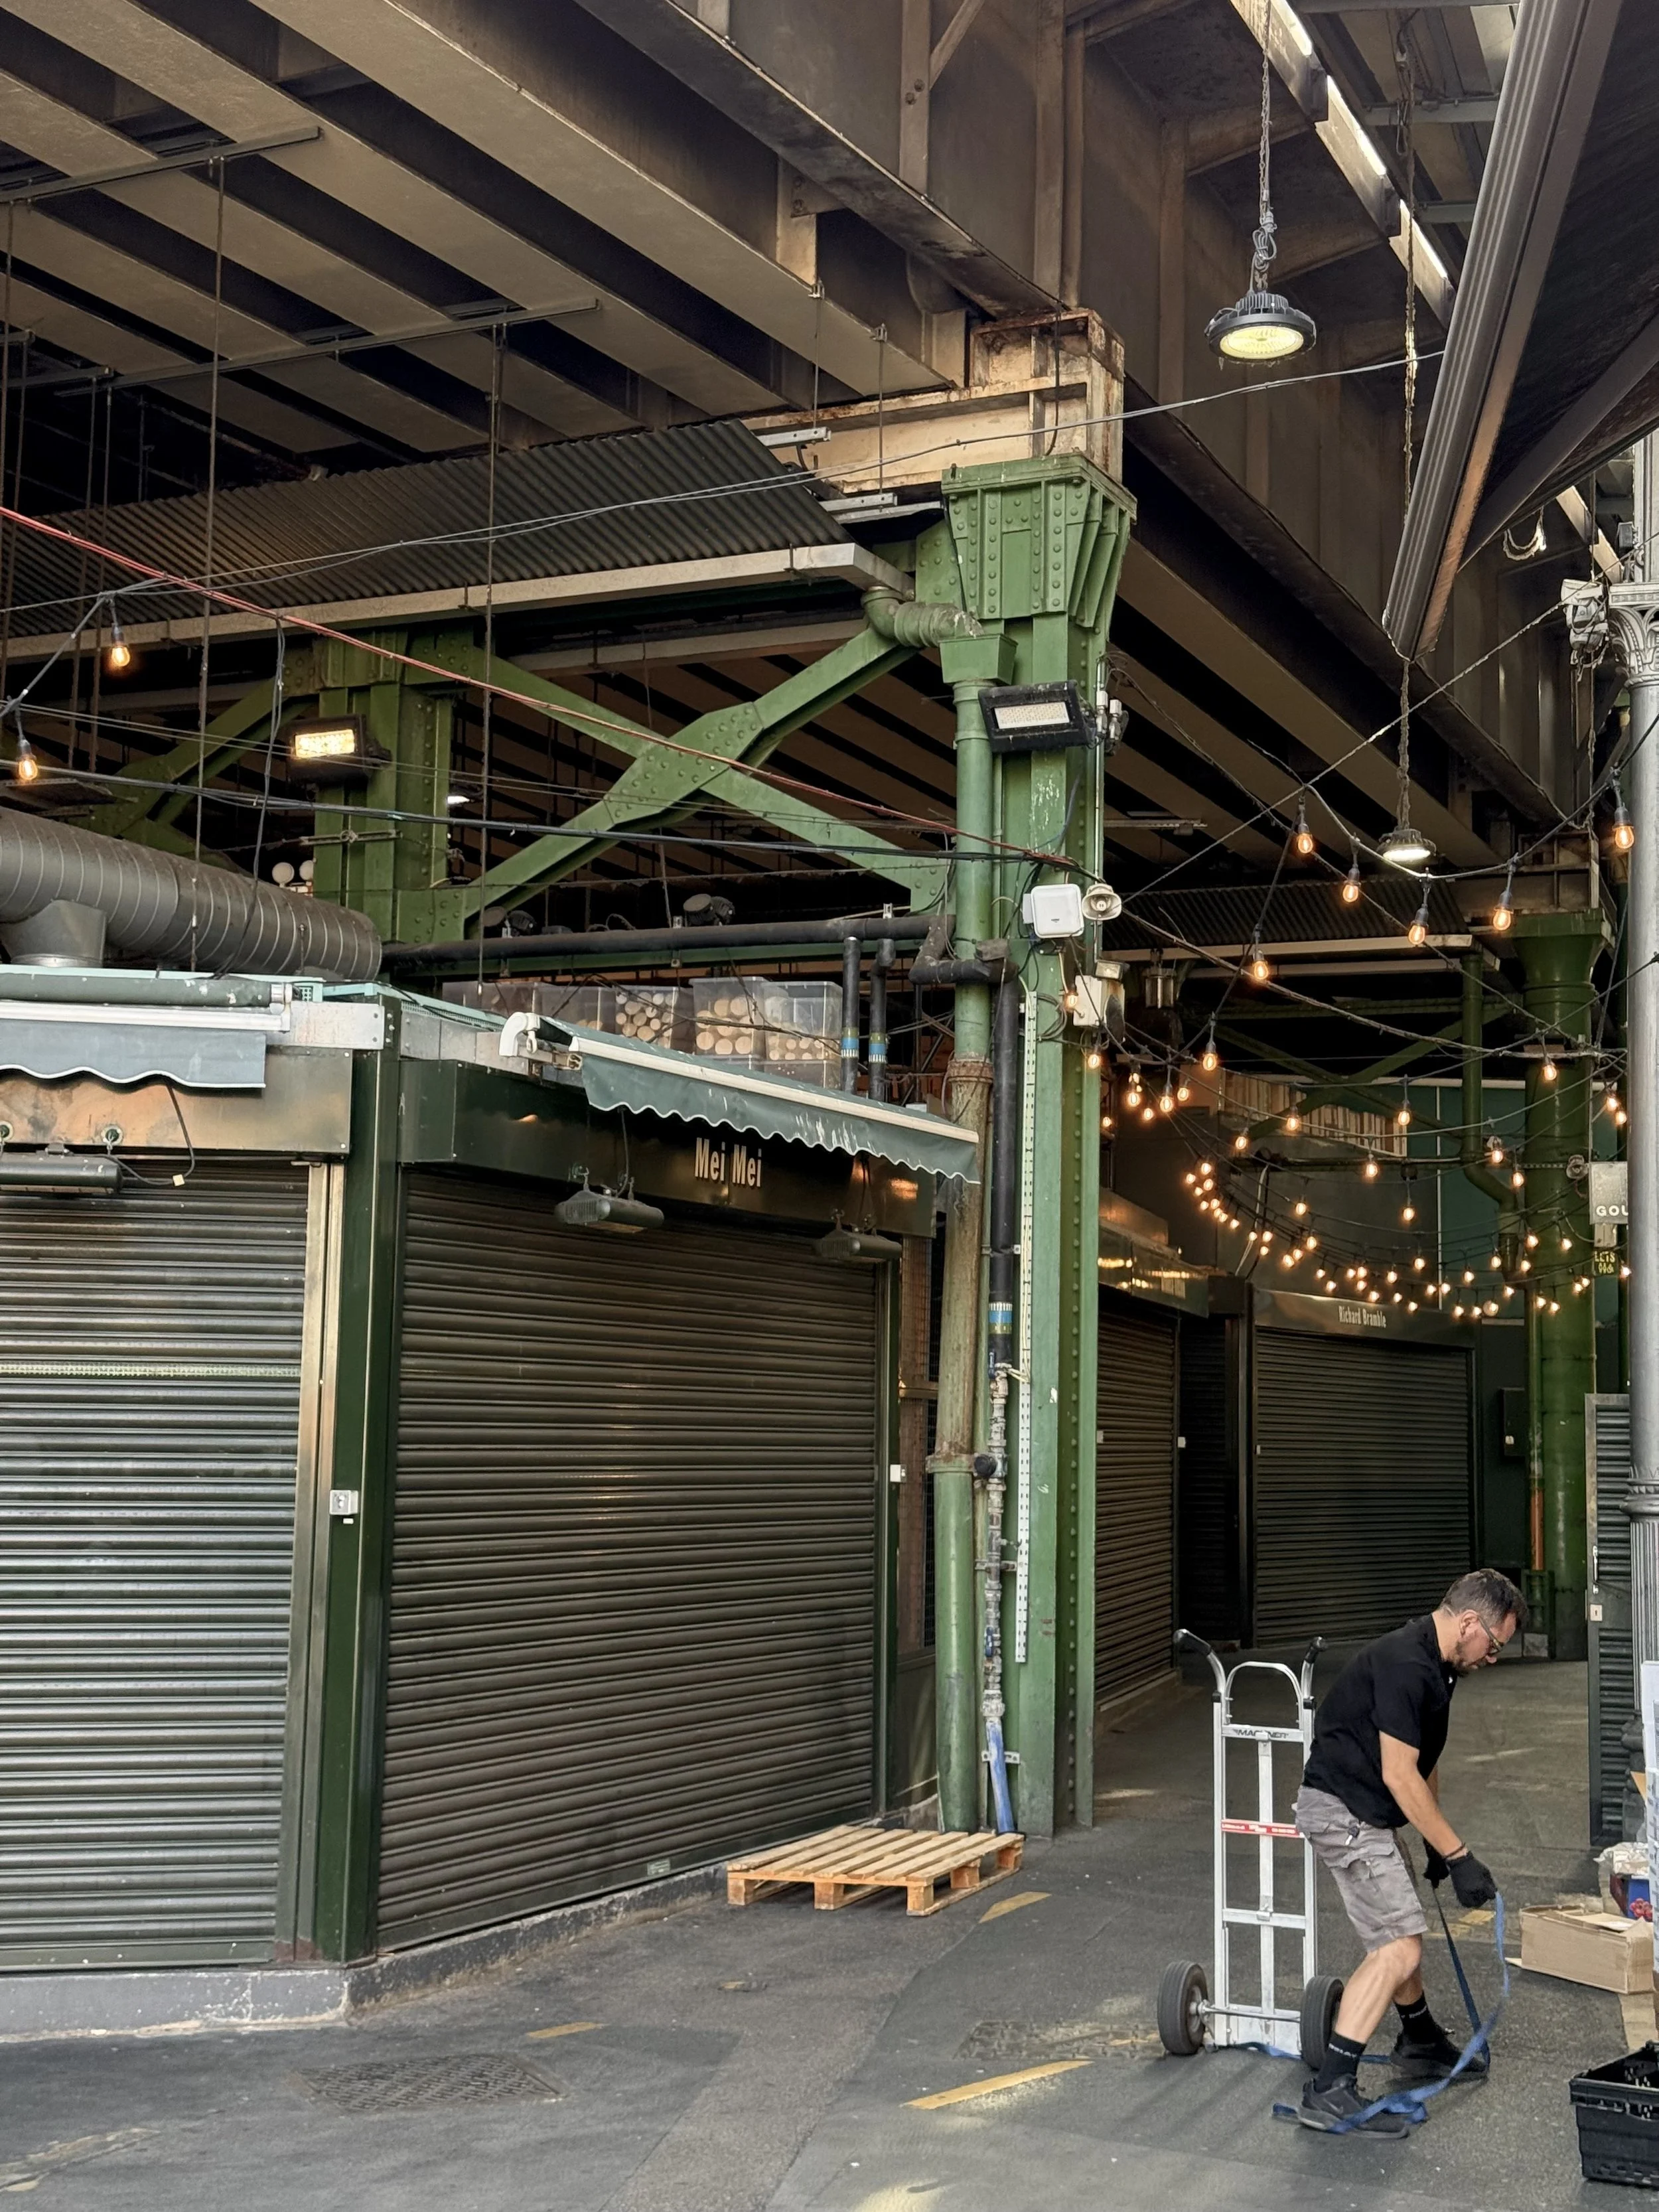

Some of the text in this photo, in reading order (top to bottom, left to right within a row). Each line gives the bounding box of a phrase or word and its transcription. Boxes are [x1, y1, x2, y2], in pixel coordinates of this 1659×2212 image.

[695, 1137, 762, 1187] Mei Mei
[1338, 1305, 1387, 1328] Richard Bramble
